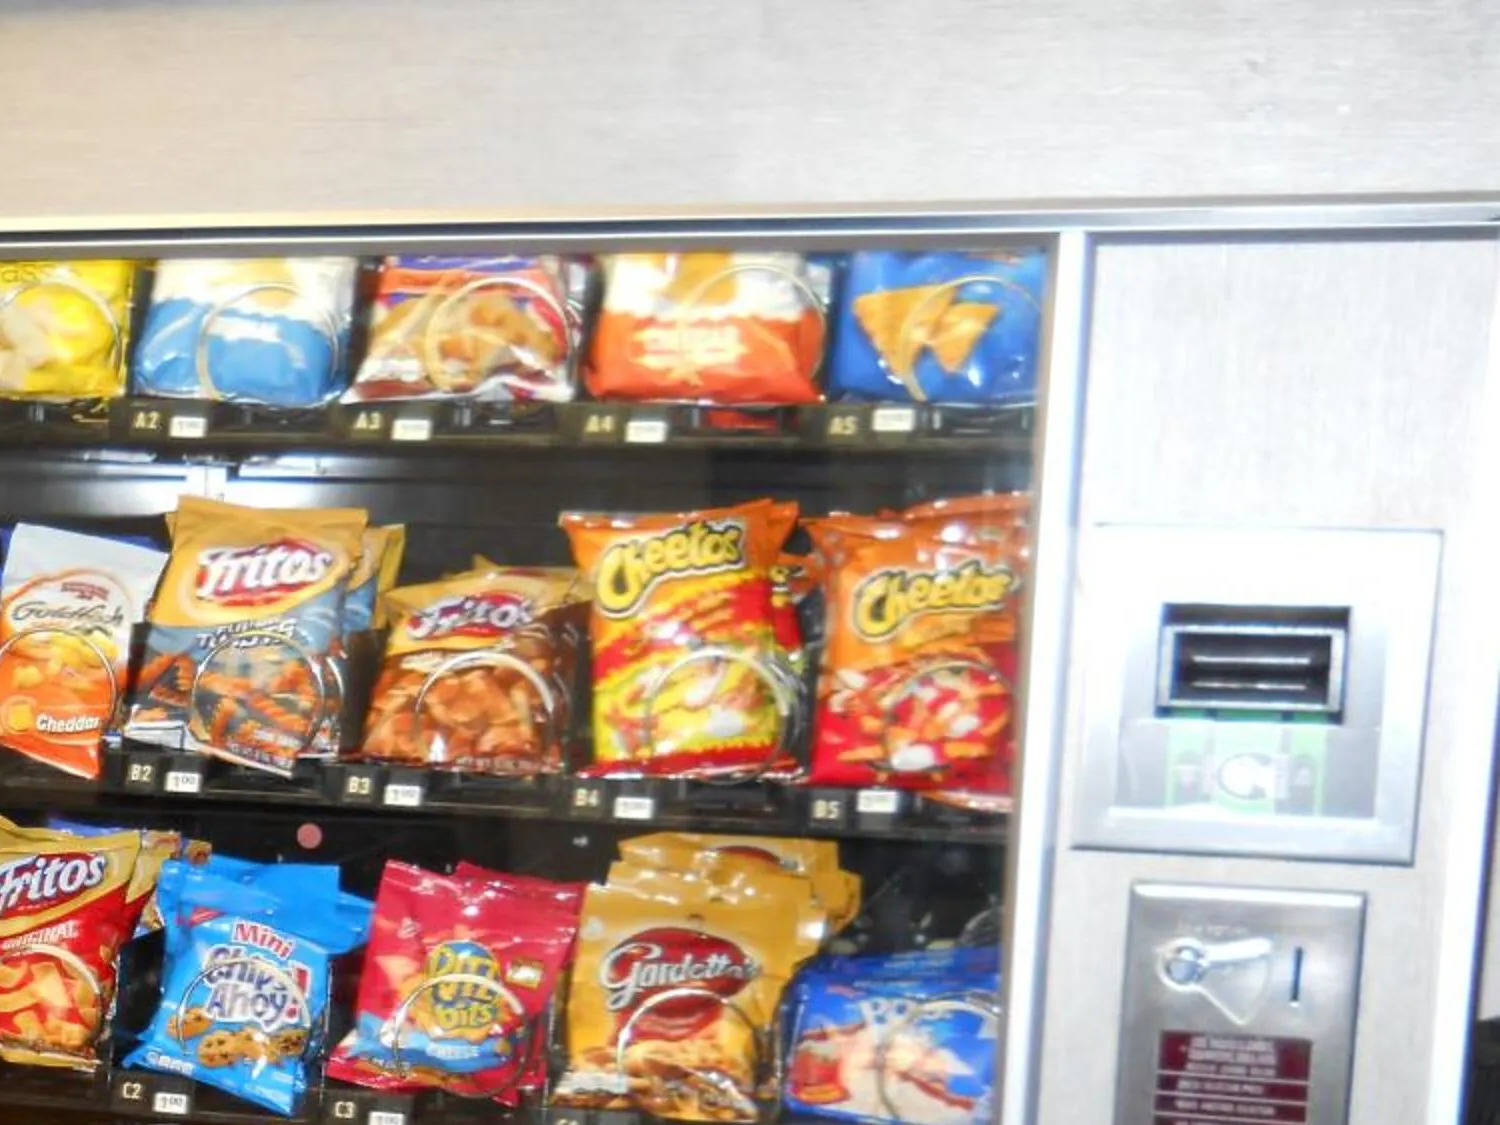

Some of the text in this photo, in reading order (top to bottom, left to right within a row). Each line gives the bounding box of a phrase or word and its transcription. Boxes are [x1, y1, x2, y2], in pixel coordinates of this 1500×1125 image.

[134, 411, 159, 430] A2
[353, 410, 382, 430] A3
[585, 414, 615, 433] A4
[197, 540, 334, 600] Fritos
[596, 522, 743, 613] Cheetos
[854, 560, 1015, 639] Cheetos
[131, 764, 152, 781] B2
[348, 776, 371, 794] B3
[233, 918, 295, 960] Mini
[122, 1081, 142, 1100] C2
[334, 1101, 355, 1119] C3
